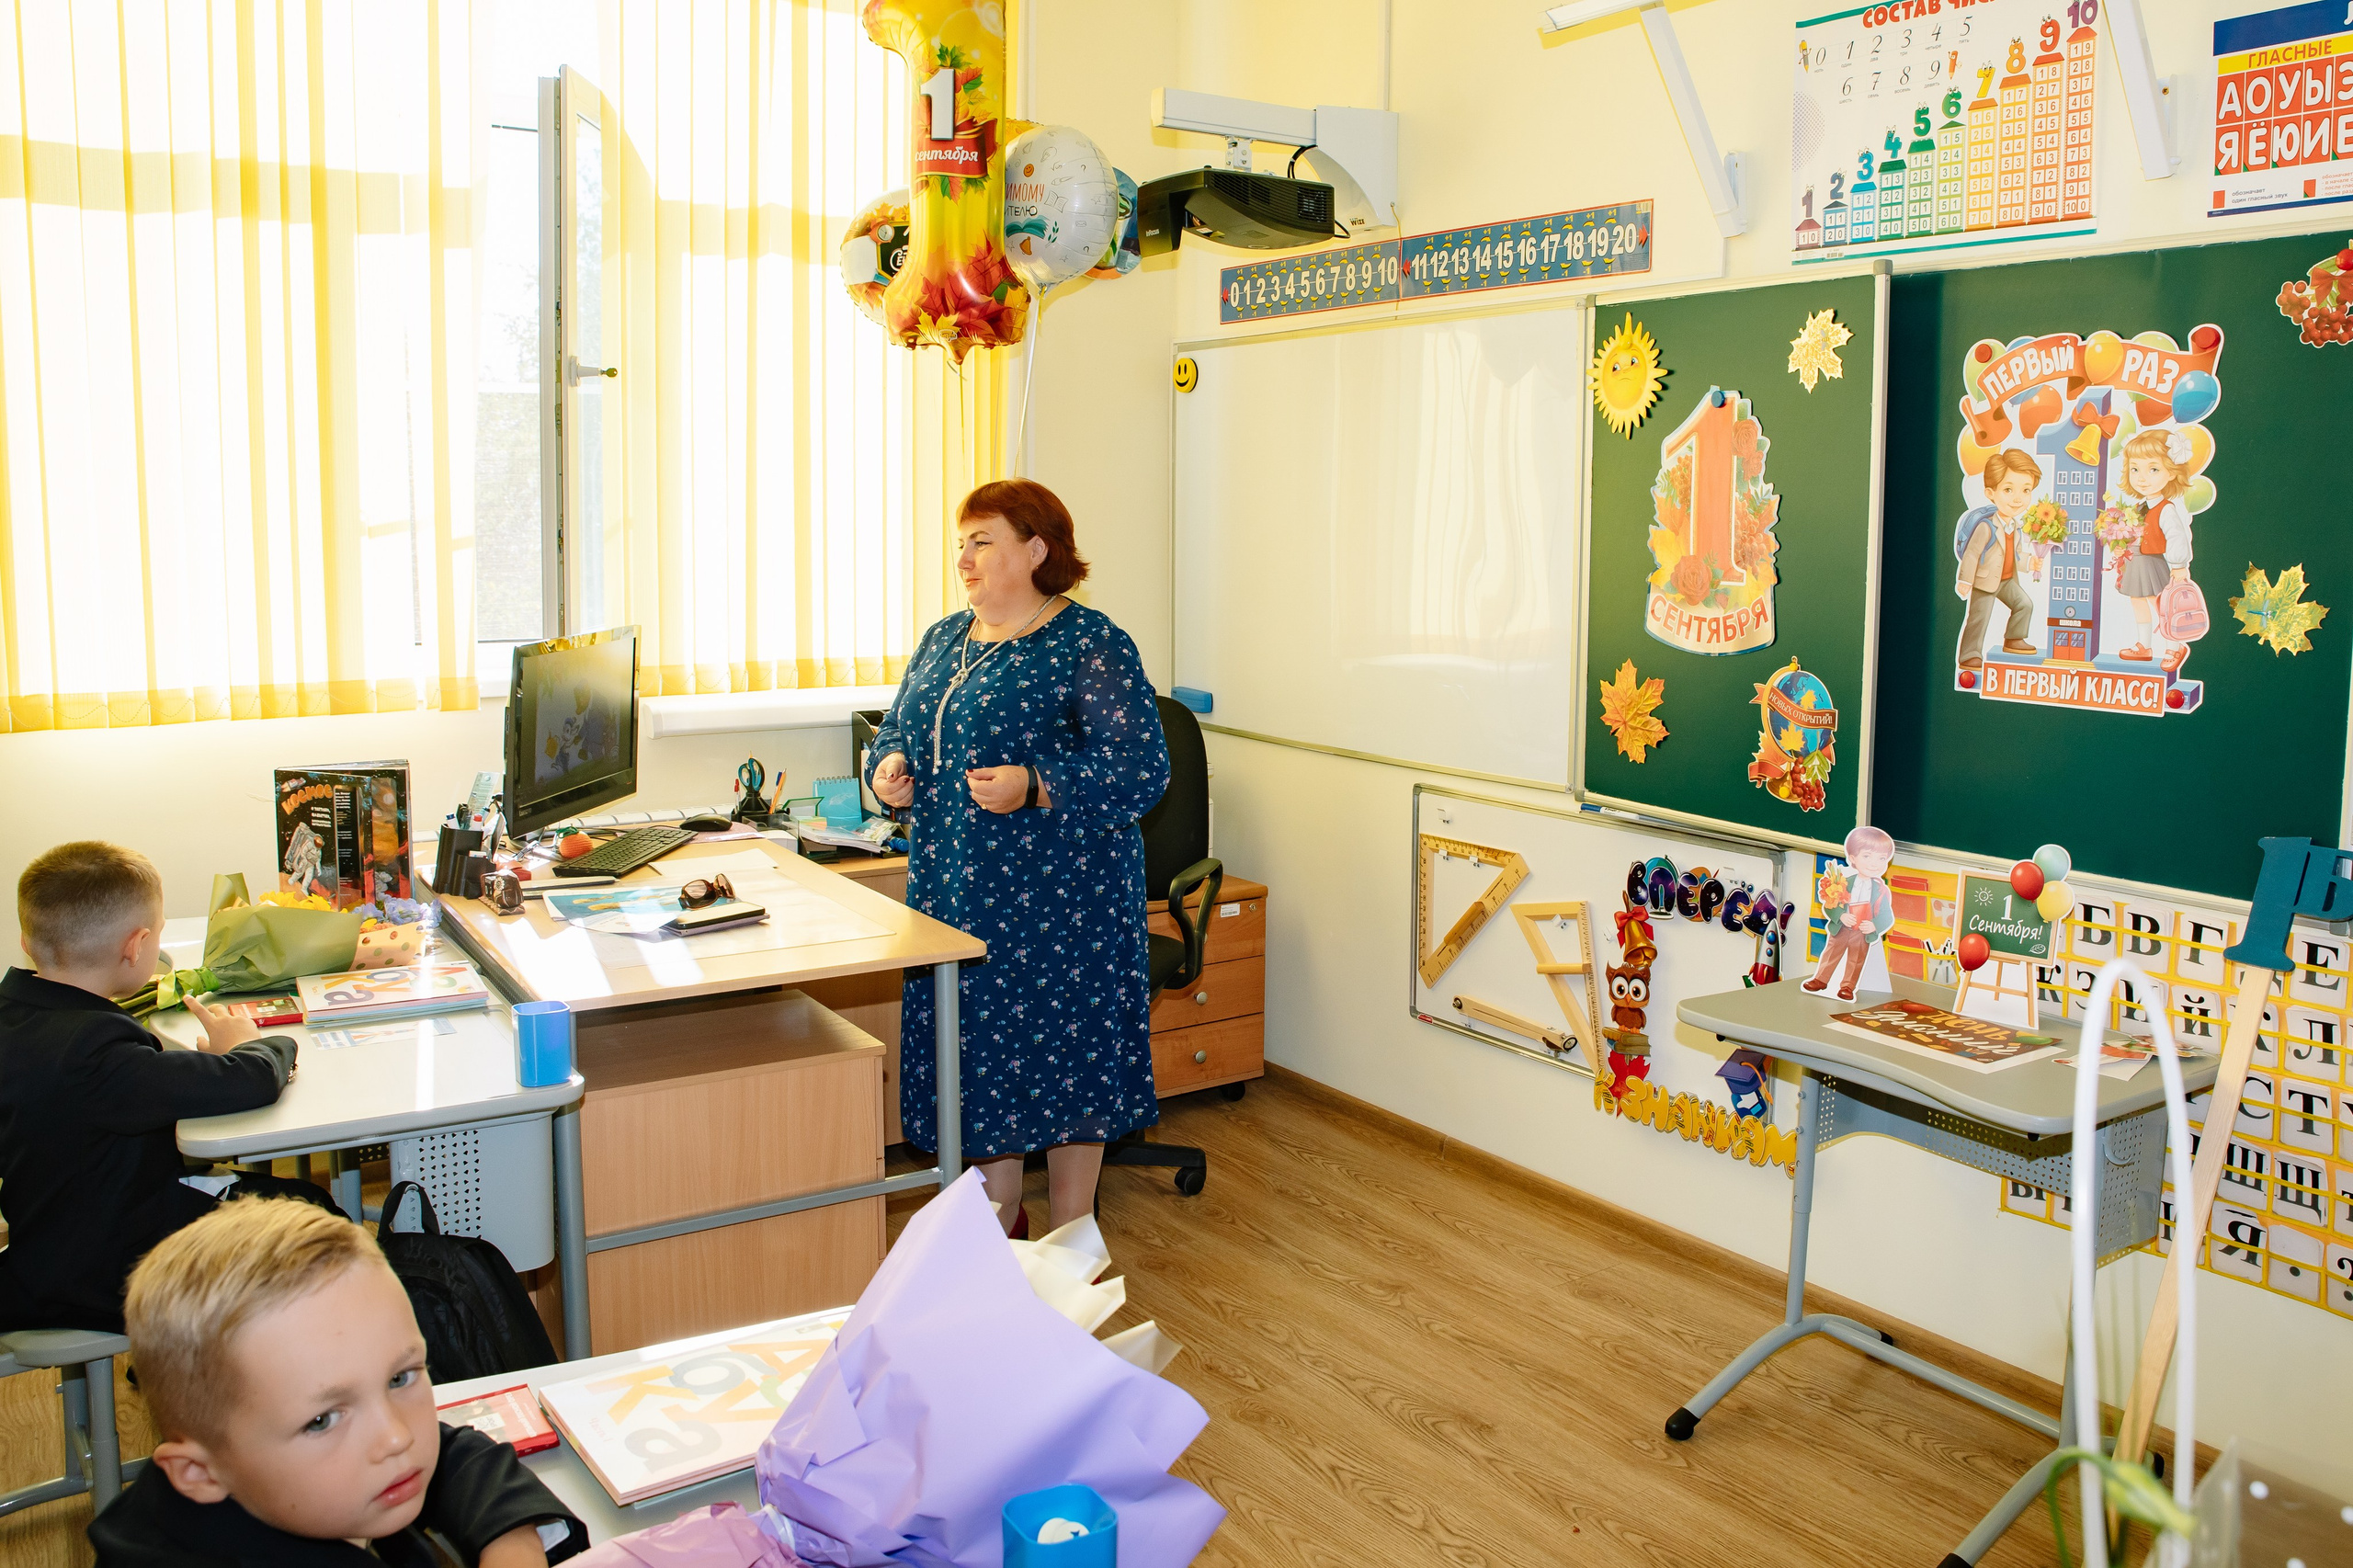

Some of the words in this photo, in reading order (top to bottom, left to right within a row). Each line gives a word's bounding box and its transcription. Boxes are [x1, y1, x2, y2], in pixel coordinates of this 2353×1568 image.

[1862, 0, 1941, 28] СОСТАВ
[2067, 0, 2097, 28] 10
[1815, 47, 1826, 66] 0
[1847, 40, 1855, 60] 1
[1871, 35, 1882, 54] 2
[1901, 28, 1913, 49] 3
[1931, 22, 1942, 42] 4
[1960, 16, 1973, 37] 5
[2040, 18, 2060, 52] 9
[2074, 45, 2078, 55] 1
[2085, 42, 2091, 52] 9
[2006, 41, 2026, 74] 8
[2073, 62, 2078, 73] 2
[2085, 60, 2090, 70] 8
[2248, 40, 2333, 68] ГЛАСНЫЕ
[1842, 76, 1854, 97] 6
[1871, 71, 1881, 91] 7
[1899, 65, 1912, 85] 8
[1928, 60, 1941, 80] 9
[1977, 66, 1995, 98] 7
[2072, 80, 2078, 90] 3
[2084, 78, 2090, 88] 7
[2218, 81, 2243, 120] А
[2245, 76, 2272, 115] О
[2278, 69, 2302, 110] У
[2305, 64, 2333, 107] Ы
[920, 68, 954, 141] 1
[1942, 91, 1961, 119] 6
[2072, 97, 2077, 108] 4
[2084, 95, 2089, 105] 6
[1914, 107, 1931, 136] 5
[2071, 115, 2077, 125] 5
[2083, 113, 2089, 123] 5
[1884, 130, 1902, 158] 4
[2071, 133, 2076, 143] 6
[2083, 131, 2088, 141] 4
[2217, 131, 2240, 170] Я
[2248, 120, 2268, 165] Ё
[2272, 122, 2301, 163] Ю
[2302, 117, 2330, 159] И
[915, 145, 979, 165] сентября
[1857, 152, 1874, 181] 3
[2070, 150, 2076, 160] 7
[2082, 148, 2088, 158] 3
[1830, 173, 1844, 199] 2
[2069, 167, 2075, 178] 8
[2081, 166, 2087, 175] 2
[1006, 183, 1045, 202] ИМОМУ
[2069, 185, 2074, 195] 9
[2081, 183, 2086, 193] 1
[2232, 187, 2266, 196] обозначает
[2247, 194, 2273, 202] гласный
[2274, 192, 2288, 200] звук
[1802, 190, 1813, 218] 1
[2066, 202, 2076, 212] 10
[2080, 201, 2086, 211] 0
[1411, 253, 1427, 280] 11
[1430, 250, 1449, 278] 12
[1451, 246, 1470, 276] 13
[1472, 244, 1492, 272] 14
[1494, 240, 1514, 269] 15
[1517, 236, 1537, 267] 16
[1540, 233, 1562, 264] 17
[1563, 230, 1585, 261] 18
[1587, 226, 1609, 257] 19
[1611, 222, 1637, 256] 20
[1230, 281, 1240, 308] 0
[1243, 279, 1251, 305] 1
[1256, 278, 1266, 304] 2
[1270, 275, 1280, 301] 3
[1284, 272, 1295, 300] 4
[1300, 270, 1310, 298] 5
[1315, 268, 1326, 295] 6
[1330, 265, 1341, 293] 7
[1345, 263, 1356, 291] 8
[1361, 260, 1372, 289] 9
[1377, 256, 1398, 286] 10
[1983, 339, 2075, 401] ПЕРВЫЙ
[2120, 350, 2180, 394] РАЗ
[1665, 388, 1746, 586] 1
[1650, 594, 1769, 645] СЕНТЯБРЯ
[1986, 669, 1998, 691] В
[2004, 669, 2081, 701] ПЕРВЫЙ
[2085, 676, 2160, 709] КЛАСС!
[1768, 692, 1792, 715] НОВЫХ
[1792, 710, 1833, 724] ОТКРЫТИЙ!
[280, 784, 334, 815] КОСМОС
[2000, 894, 2013, 921] 1
[1969, 914, 2043, 945] Сентября!
[2078, 902, 2112, 946] Б
[2127, 911, 2162, 956] В
[2184, 920, 2223, 966] Г
[2299, 940, 2340, 991] Е
[2181, 994, 2212, 1038] Й
[2293, 1018, 2339, 1066] Л
[1620, 1074, 1798, 1179] ЗНАНИЯМ
[2288, 1089, 2328, 1136] Т
[2222, 1142, 2267, 1193] Ш
[2277, 1160, 2323, 1223] Щ
[2218, 1220, 2267, 1268] Я
